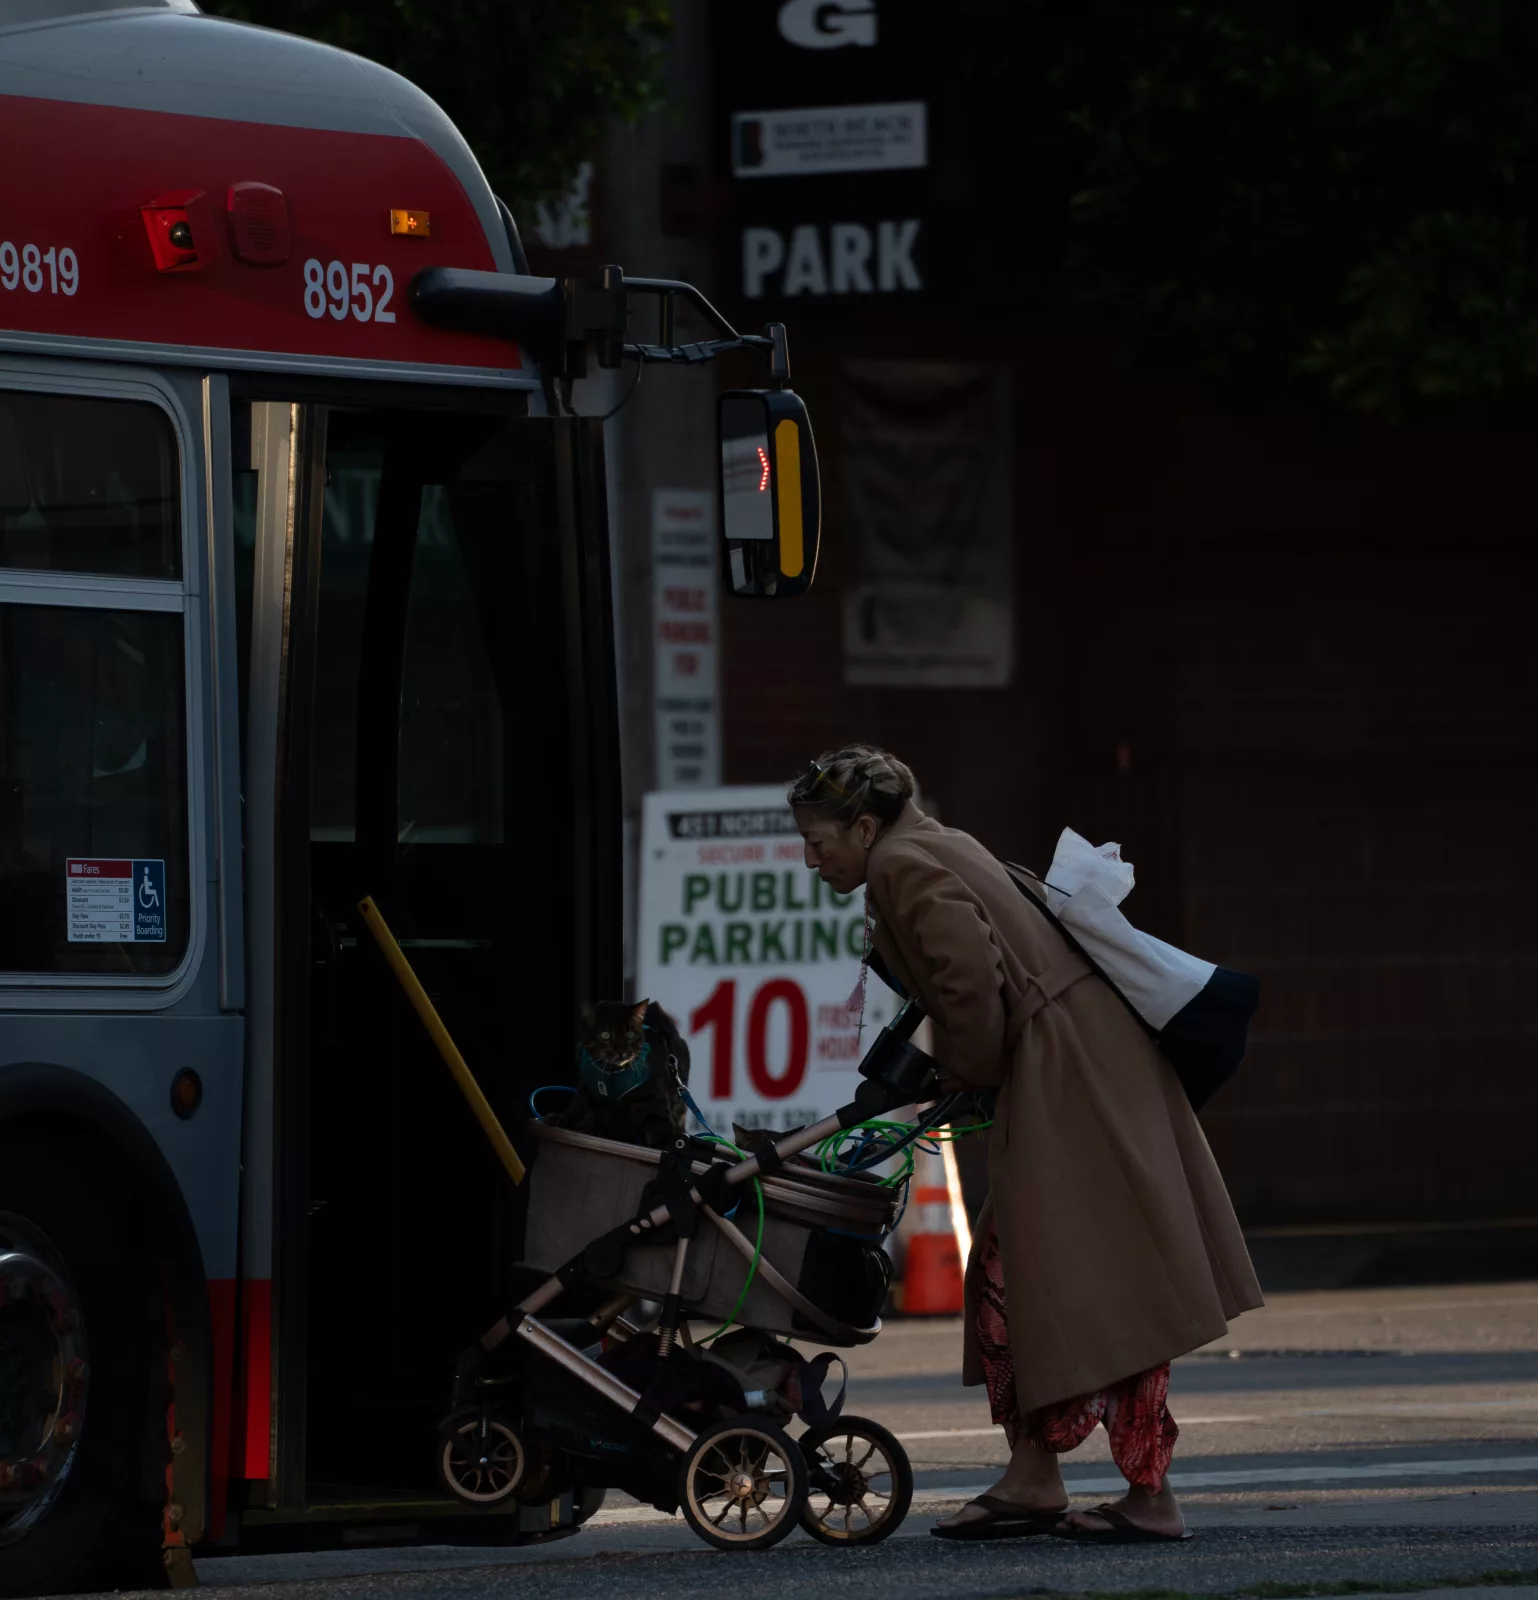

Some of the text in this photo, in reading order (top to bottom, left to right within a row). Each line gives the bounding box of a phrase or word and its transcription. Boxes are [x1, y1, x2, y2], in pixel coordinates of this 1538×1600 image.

[777, 0, 880, 50] G
[0, 241, 79, 296] 9819
[741, 218, 924, 299] PARK
[304, 259, 397, 323] 8952
[83, 864, 100, 874] Fares
[136, 925, 163, 937] Boarding
[138, 912, 161, 925] Priority
[659, 917, 873, 965] PARKING
[673, 977, 810, 1101] 10
